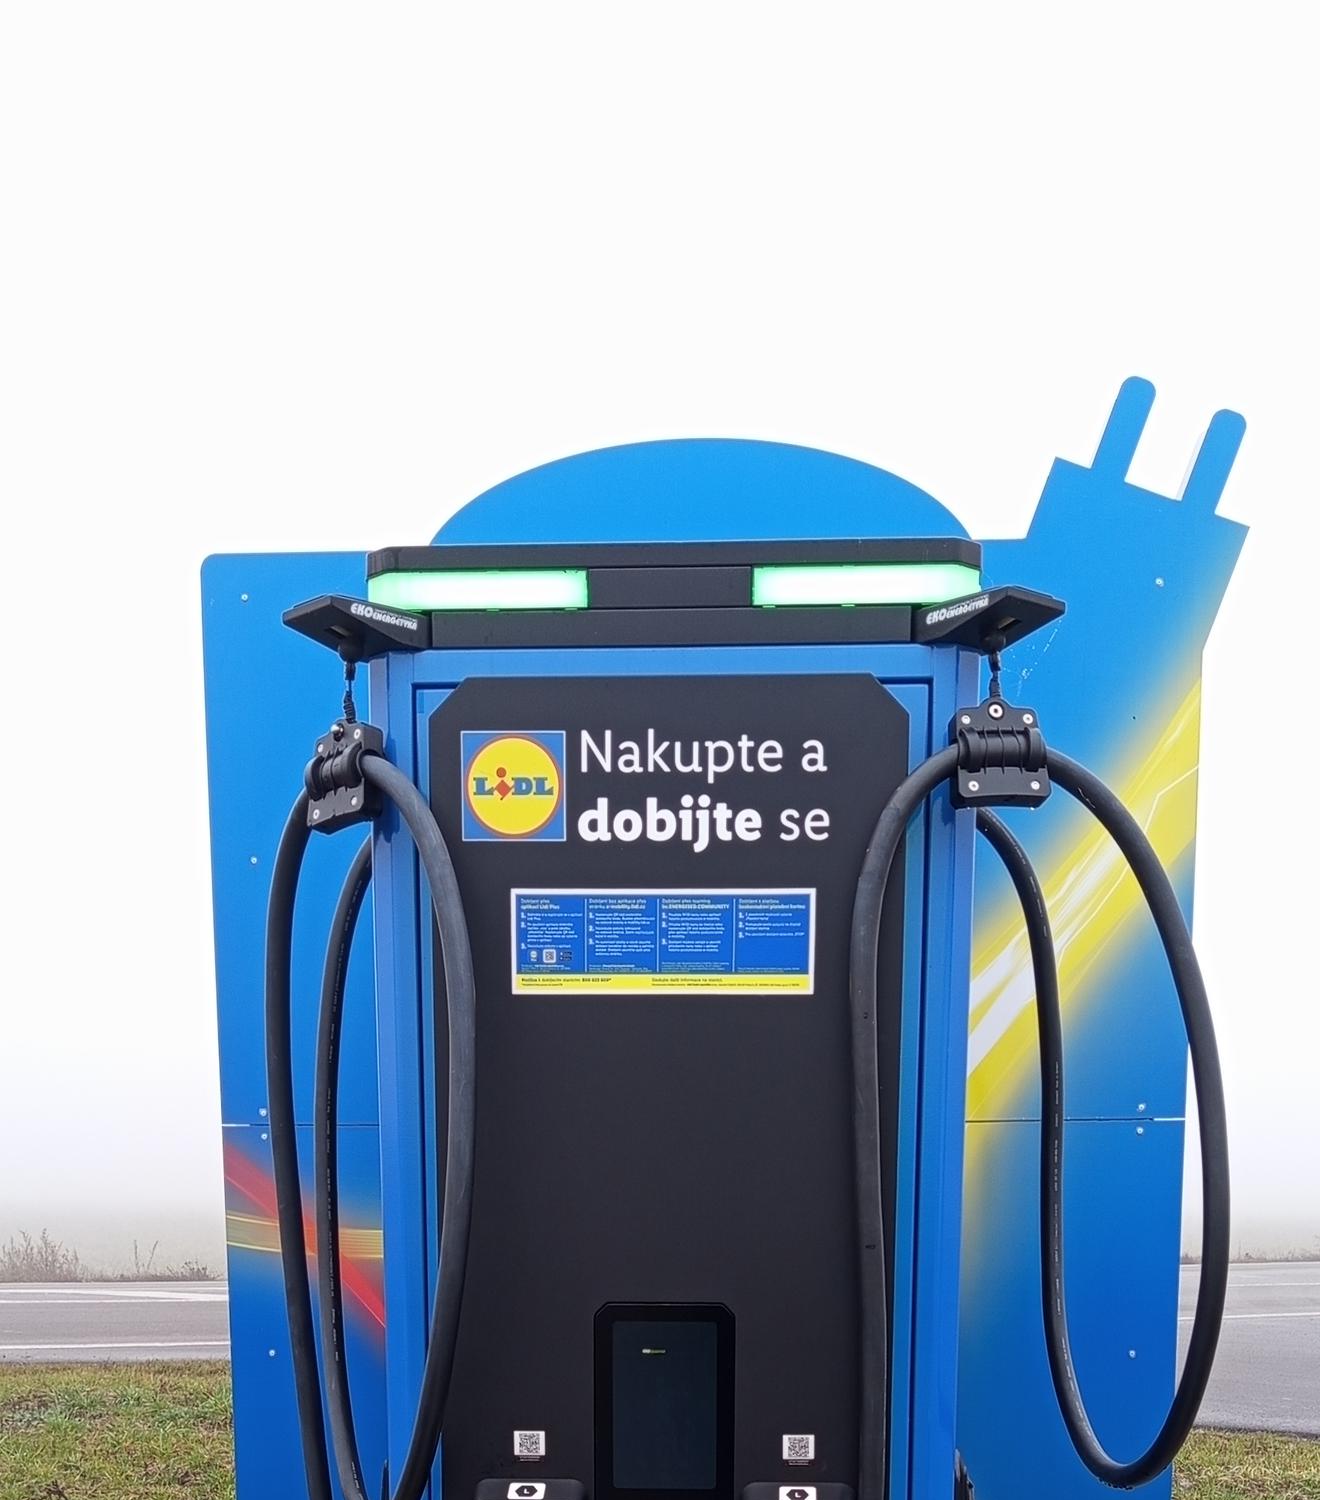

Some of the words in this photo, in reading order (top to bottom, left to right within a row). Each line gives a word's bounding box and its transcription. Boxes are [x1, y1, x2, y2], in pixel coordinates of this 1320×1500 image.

[580, 728, 784, 784] Nakupte
[800, 738, 828, 773] a
[577, 794, 763, 853] dobijte
[779, 807, 831, 841] se
